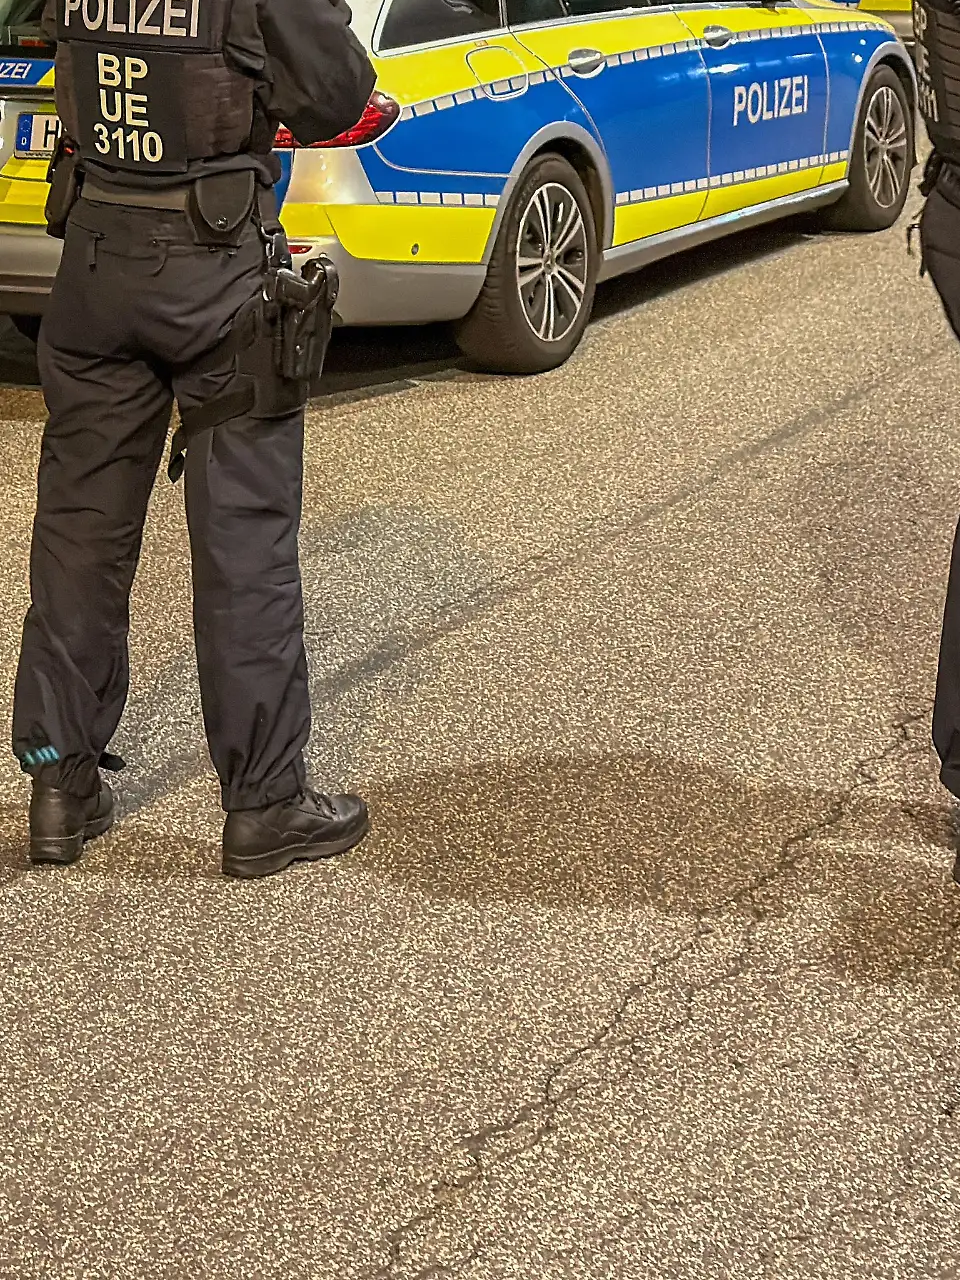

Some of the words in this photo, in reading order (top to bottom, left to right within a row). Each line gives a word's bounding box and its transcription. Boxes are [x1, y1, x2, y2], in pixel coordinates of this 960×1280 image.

[97, 52, 149, 90] BP
[99, 88, 149, 127] UE
[732, 74, 809, 127] POLIZEI
[93, 123, 164, 163] 3110
